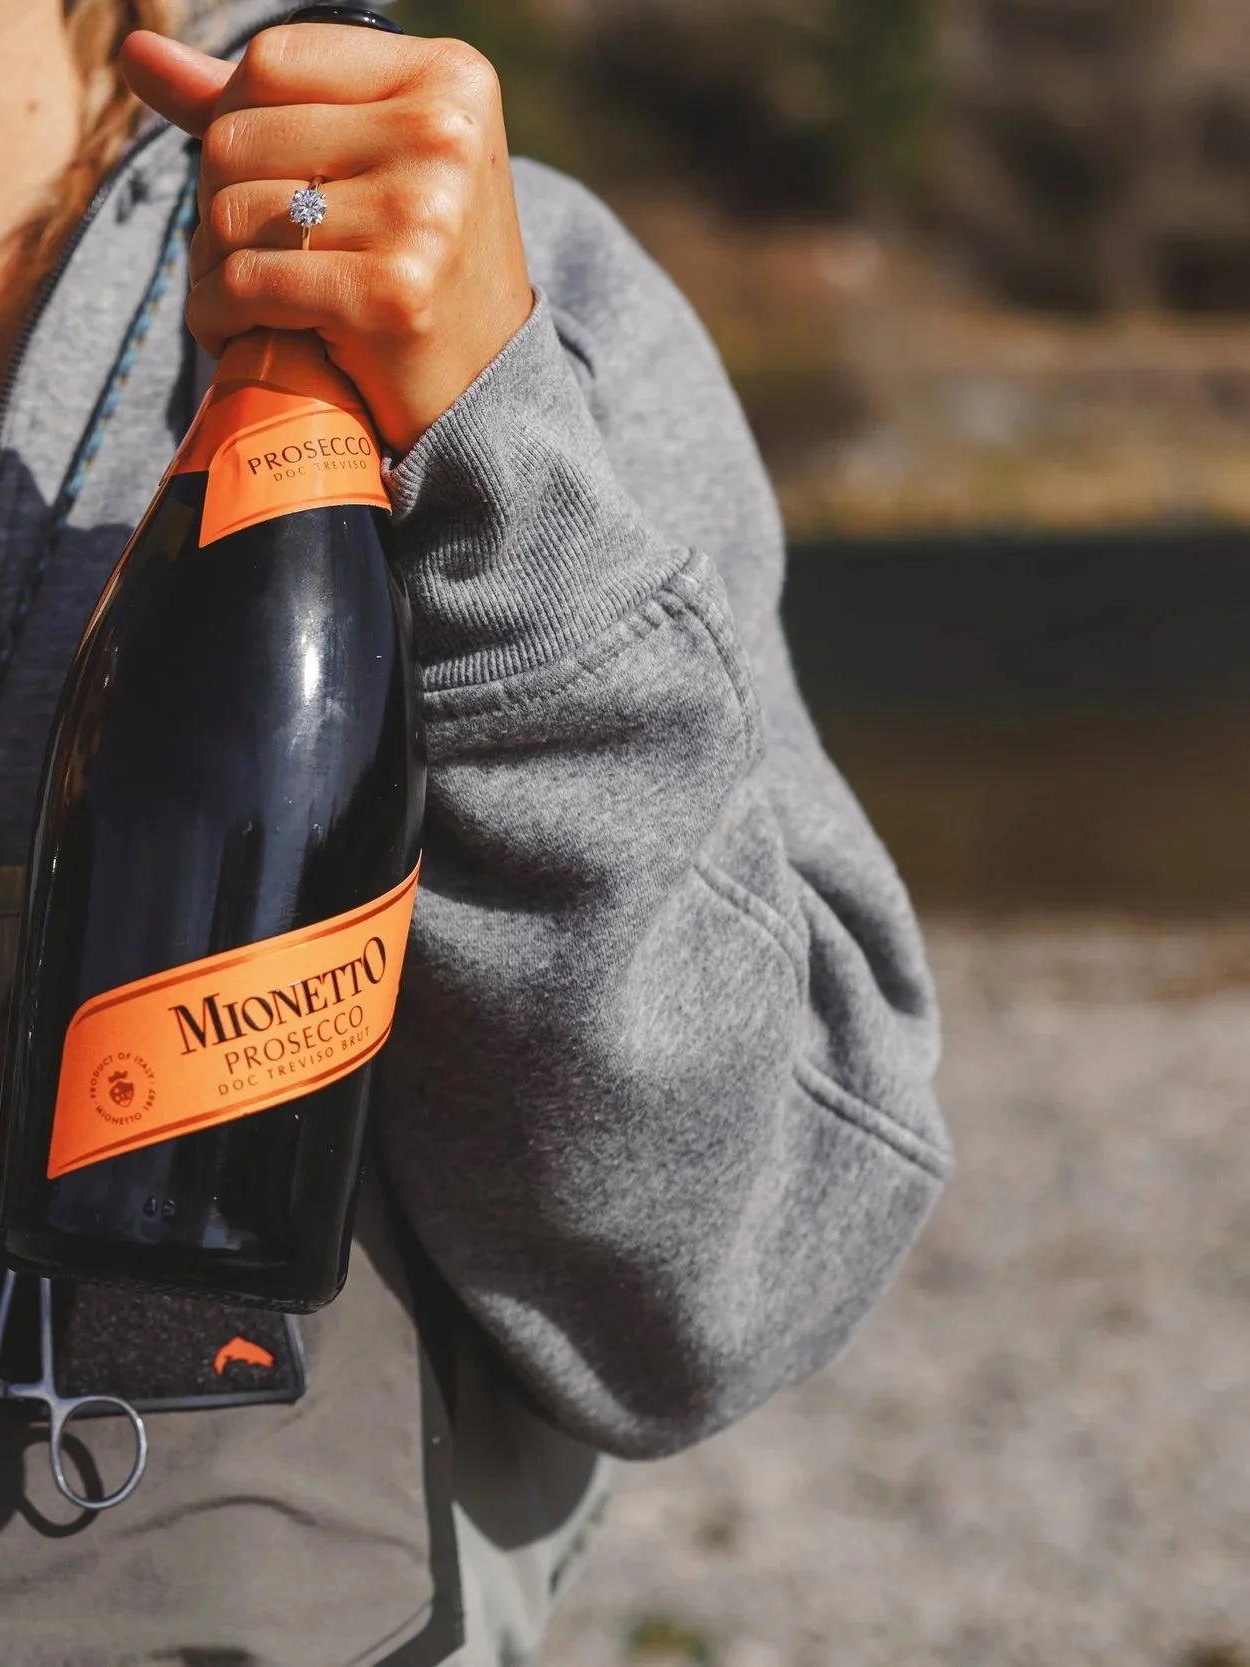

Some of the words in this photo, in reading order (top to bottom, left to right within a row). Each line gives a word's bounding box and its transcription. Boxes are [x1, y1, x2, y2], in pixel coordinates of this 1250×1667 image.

[247, 436, 372, 475] PROSECCO
[273, 466, 307, 482] DOC
[314, 459, 367, 472] TREVISO
[217, 1074, 259, 1096] DOC
[268, 1046, 334, 1081] TREVISO
[342, 1026, 371, 1051] BRUT
[224, 1005, 364, 1075] PROSECCO
